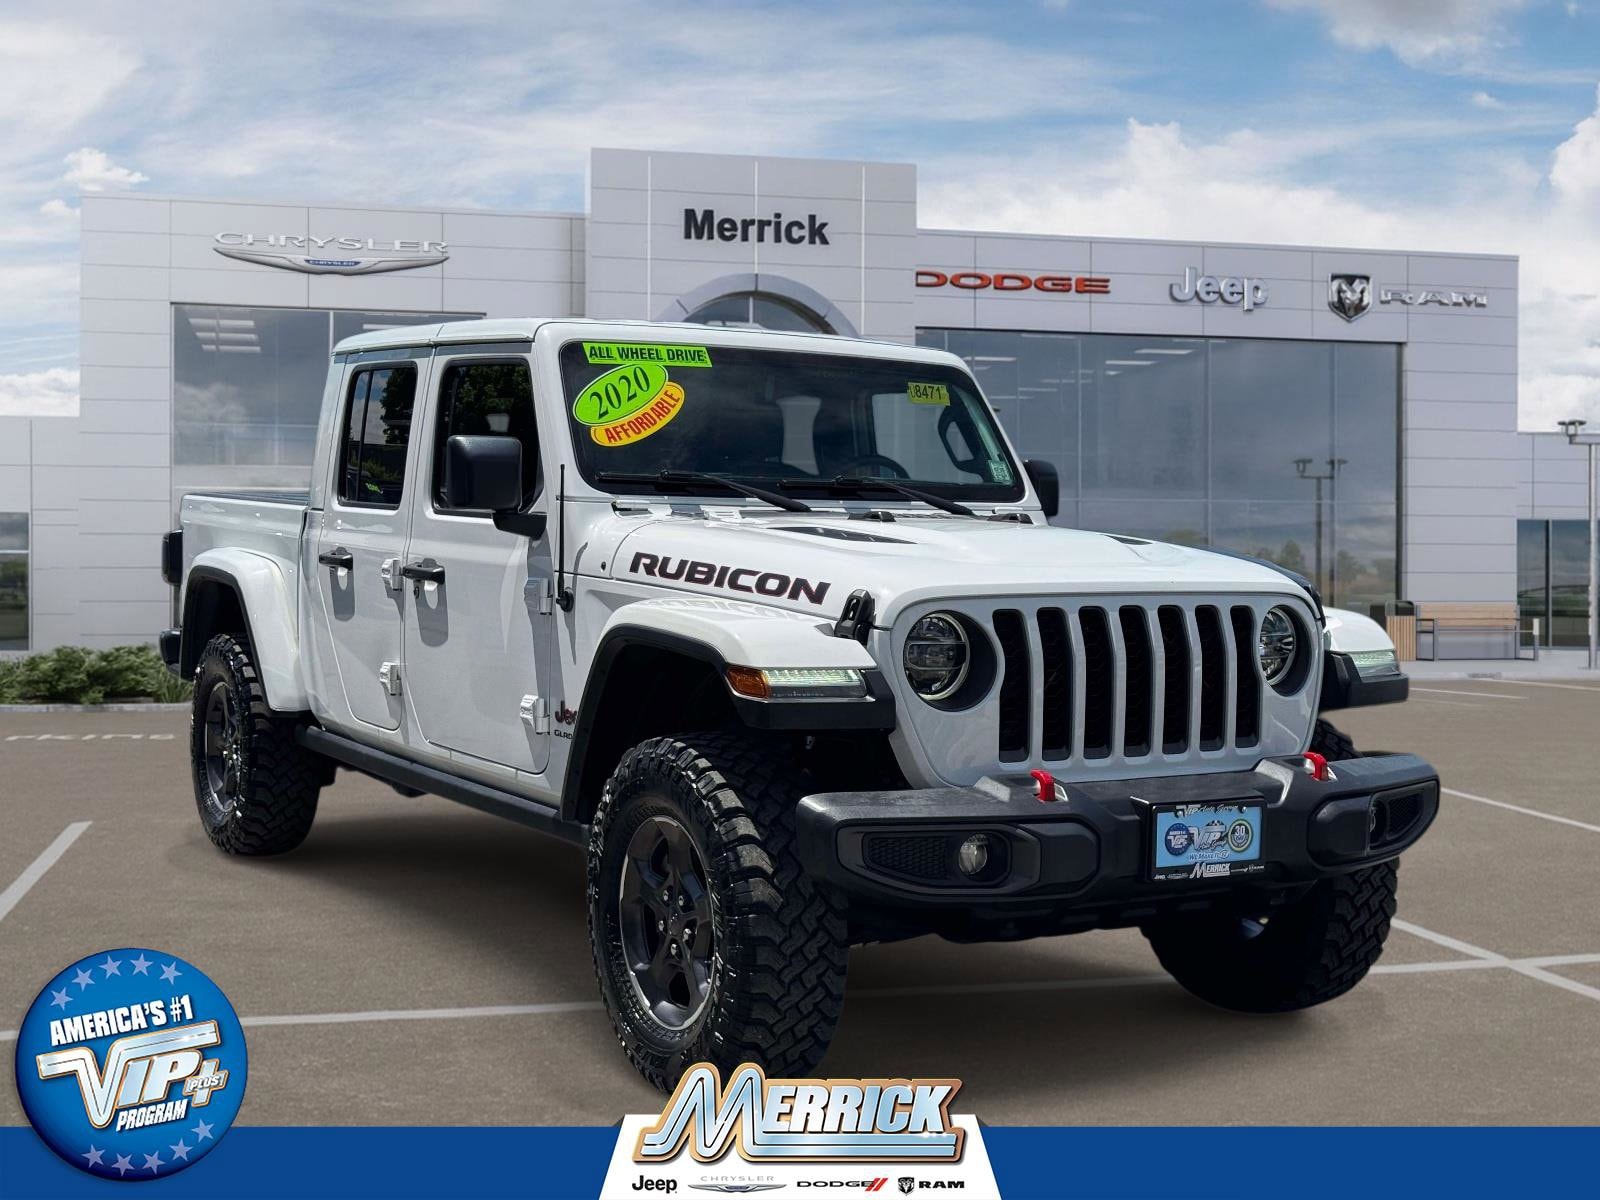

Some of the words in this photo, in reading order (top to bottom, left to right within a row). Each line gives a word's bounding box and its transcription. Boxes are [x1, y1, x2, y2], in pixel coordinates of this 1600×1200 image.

[684, 208, 830, 246] Merrick
[215, 232, 449, 253] CHRYSLER
[915, 271, 1111, 294] DODGE
[1169, 267, 1269, 311] Jeep
[1379, 289, 1488, 308] RAM
[588, 346, 615, 360] ALL
[618, 347, 664, 361] WHEEL
[666, 348, 707, 363] DRIVE
[589, 366, 651, 420] 2020
[604, 389, 681, 444] AFFORDABLE
[629, 551, 832, 606] RUBICON
[555, 700, 578, 726] Je
[1190, 862, 1231, 879] MERRICK
